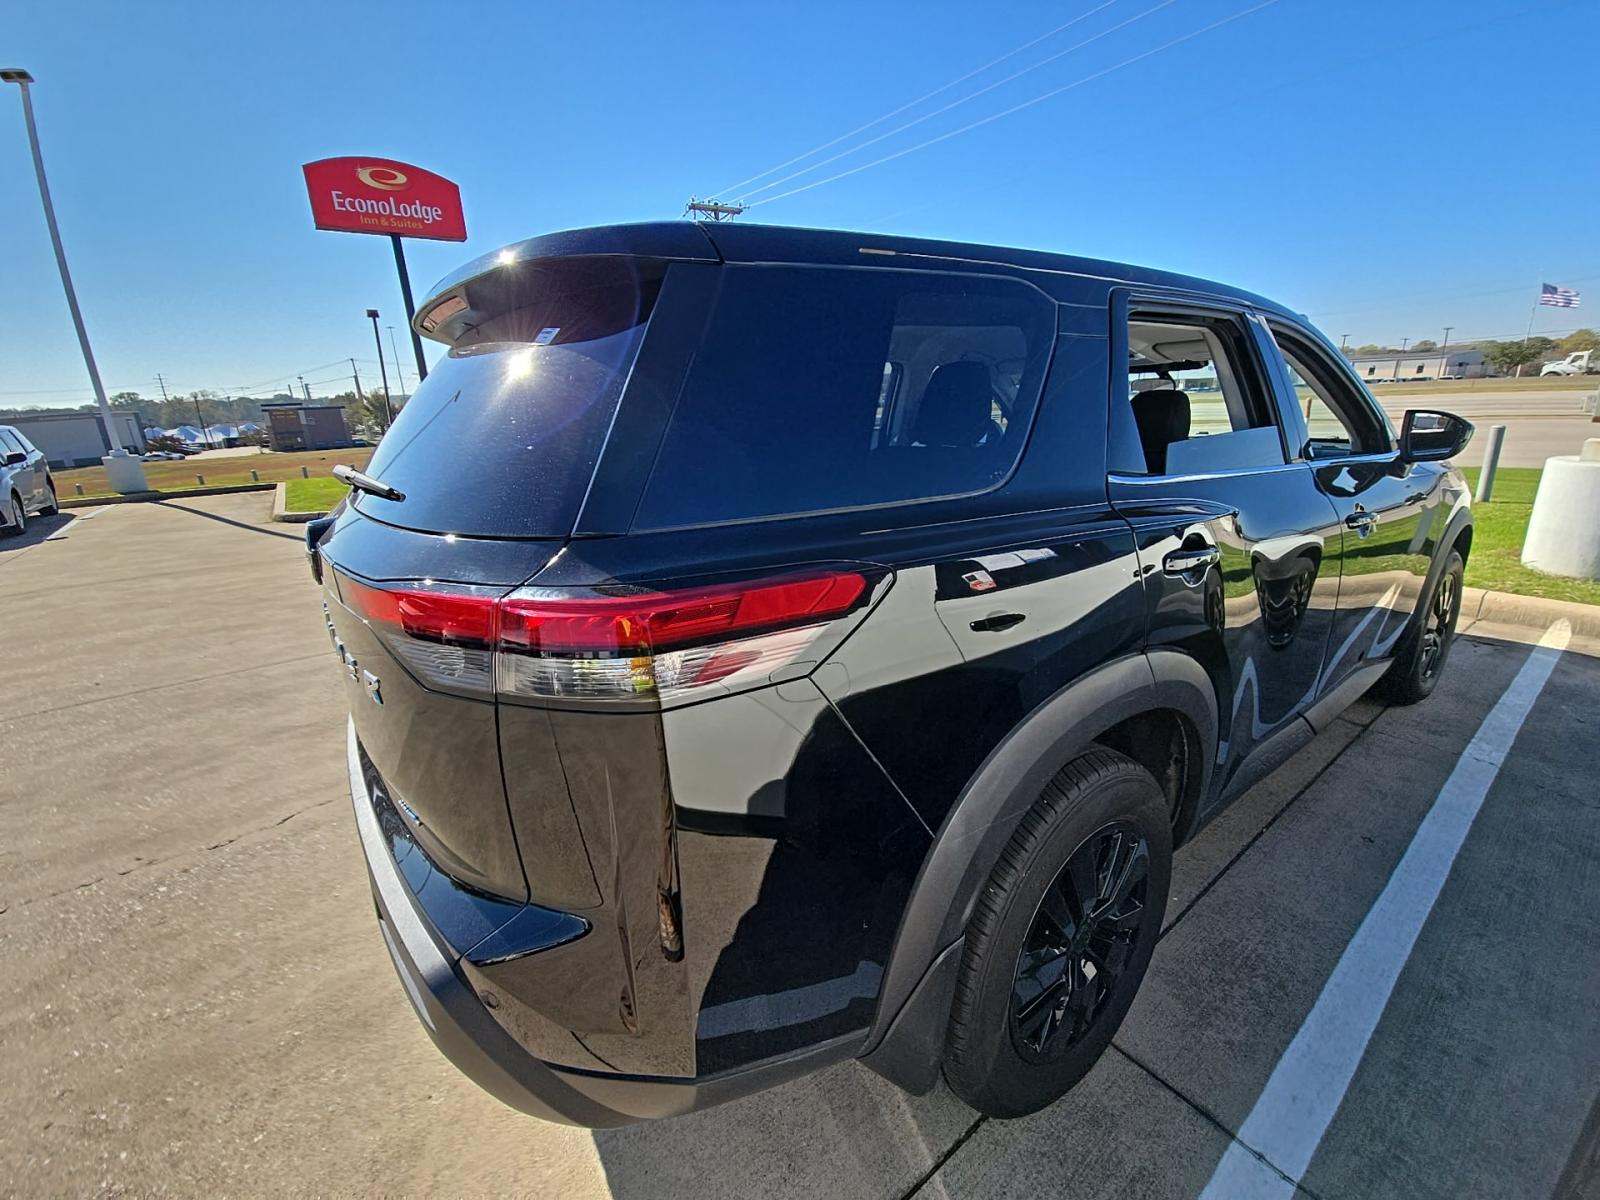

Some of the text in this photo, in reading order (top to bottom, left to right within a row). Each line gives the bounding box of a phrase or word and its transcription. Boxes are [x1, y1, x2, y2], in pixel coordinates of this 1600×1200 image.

[331, 190, 443, 223] EconoLodge
[359, 215, 423, 229] Inn & Suites
